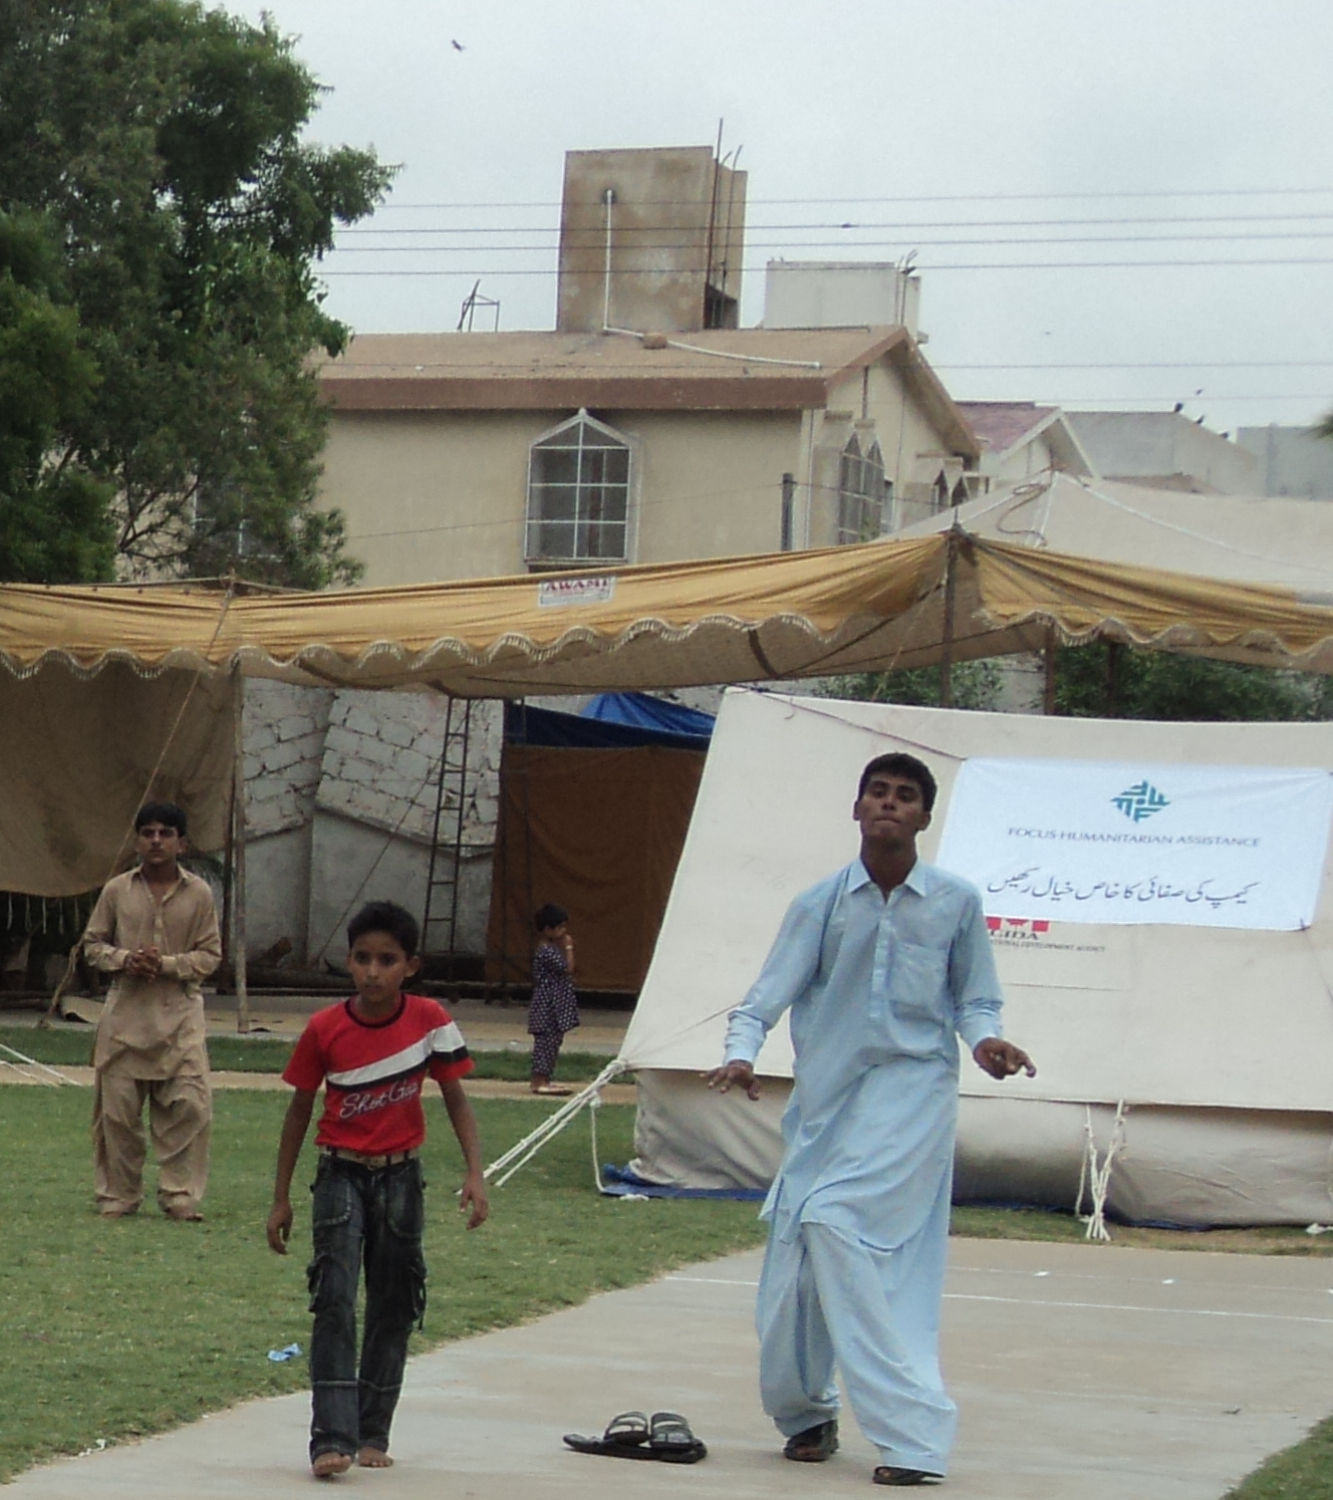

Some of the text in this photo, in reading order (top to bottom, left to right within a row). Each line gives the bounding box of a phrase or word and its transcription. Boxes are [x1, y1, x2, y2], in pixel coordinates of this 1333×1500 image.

[545, 579, 608, 592] AWAMI
[1008, 827, 1262, 848] FOCUS HUMANITARIAN ASSISTANCE
[1031, 876, 1074, 901] خیال
[1075, 882, 1121, 900] خاص
[1123, 881, 1143, 899] کا
[1137, 875, 1185, 902] صفائی
[1185, 878, 1215, 903] کی
[1205, 881, 1261, 909] کیمپ
